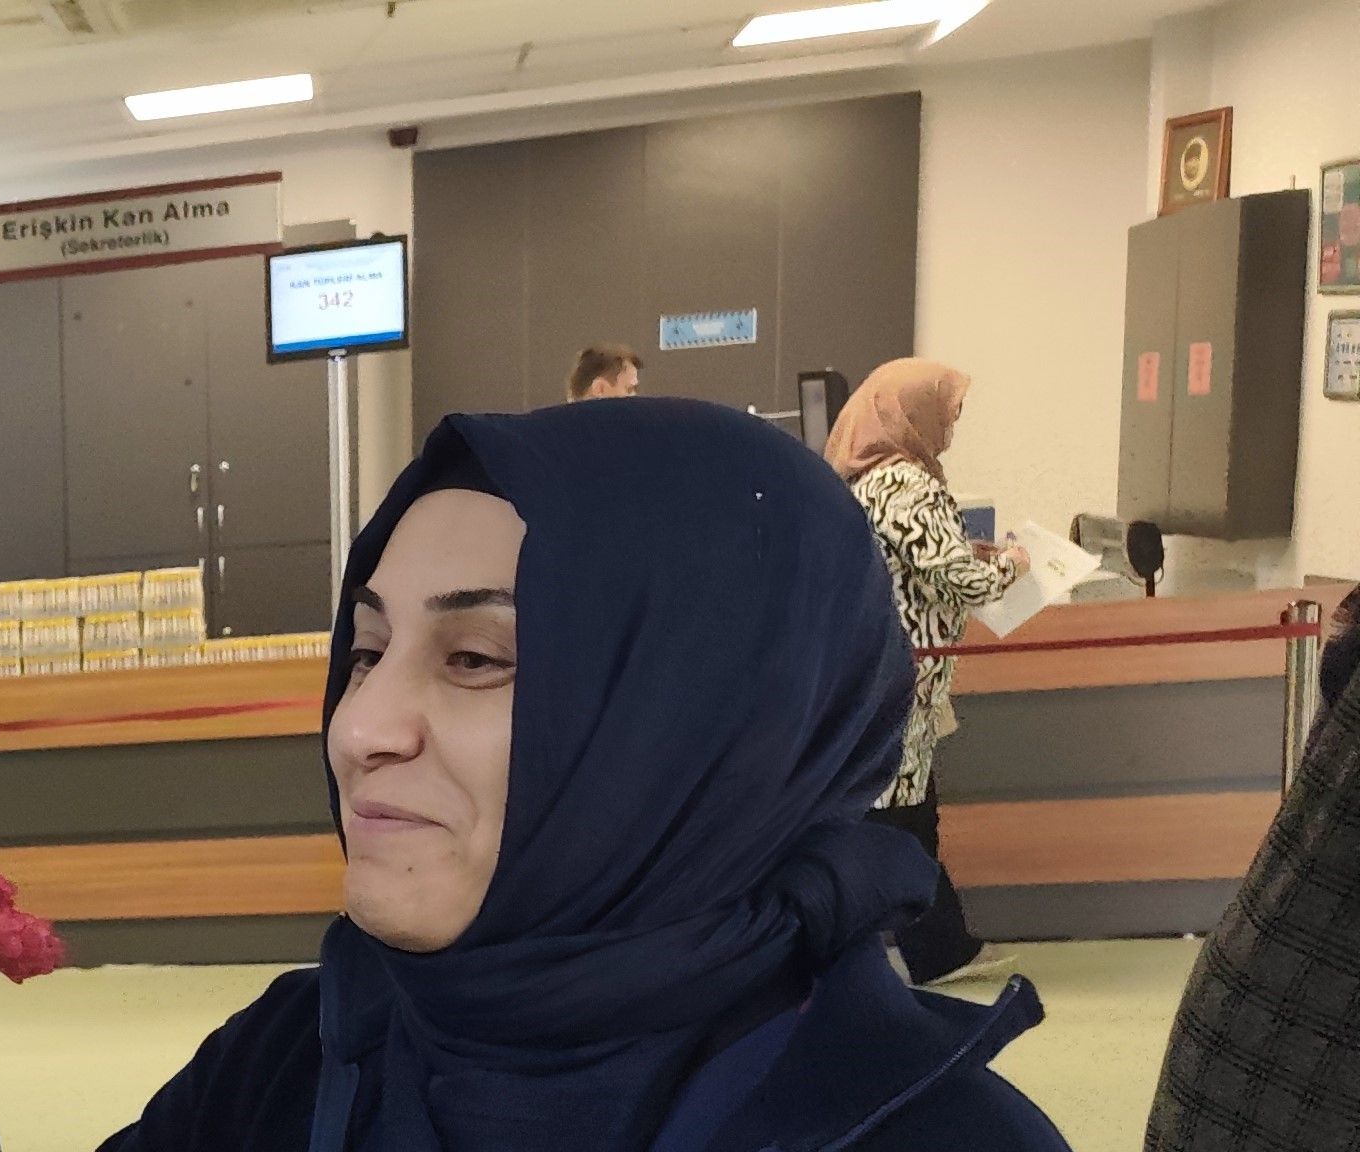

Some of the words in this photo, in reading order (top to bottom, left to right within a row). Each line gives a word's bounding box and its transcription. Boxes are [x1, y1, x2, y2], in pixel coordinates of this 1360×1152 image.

[2, 213, 93, 242] Erişkin
[103, 207, 154, 229] Kan
[164, 199, 230, 221] Alma
[318, 290, 355, 311] 342
